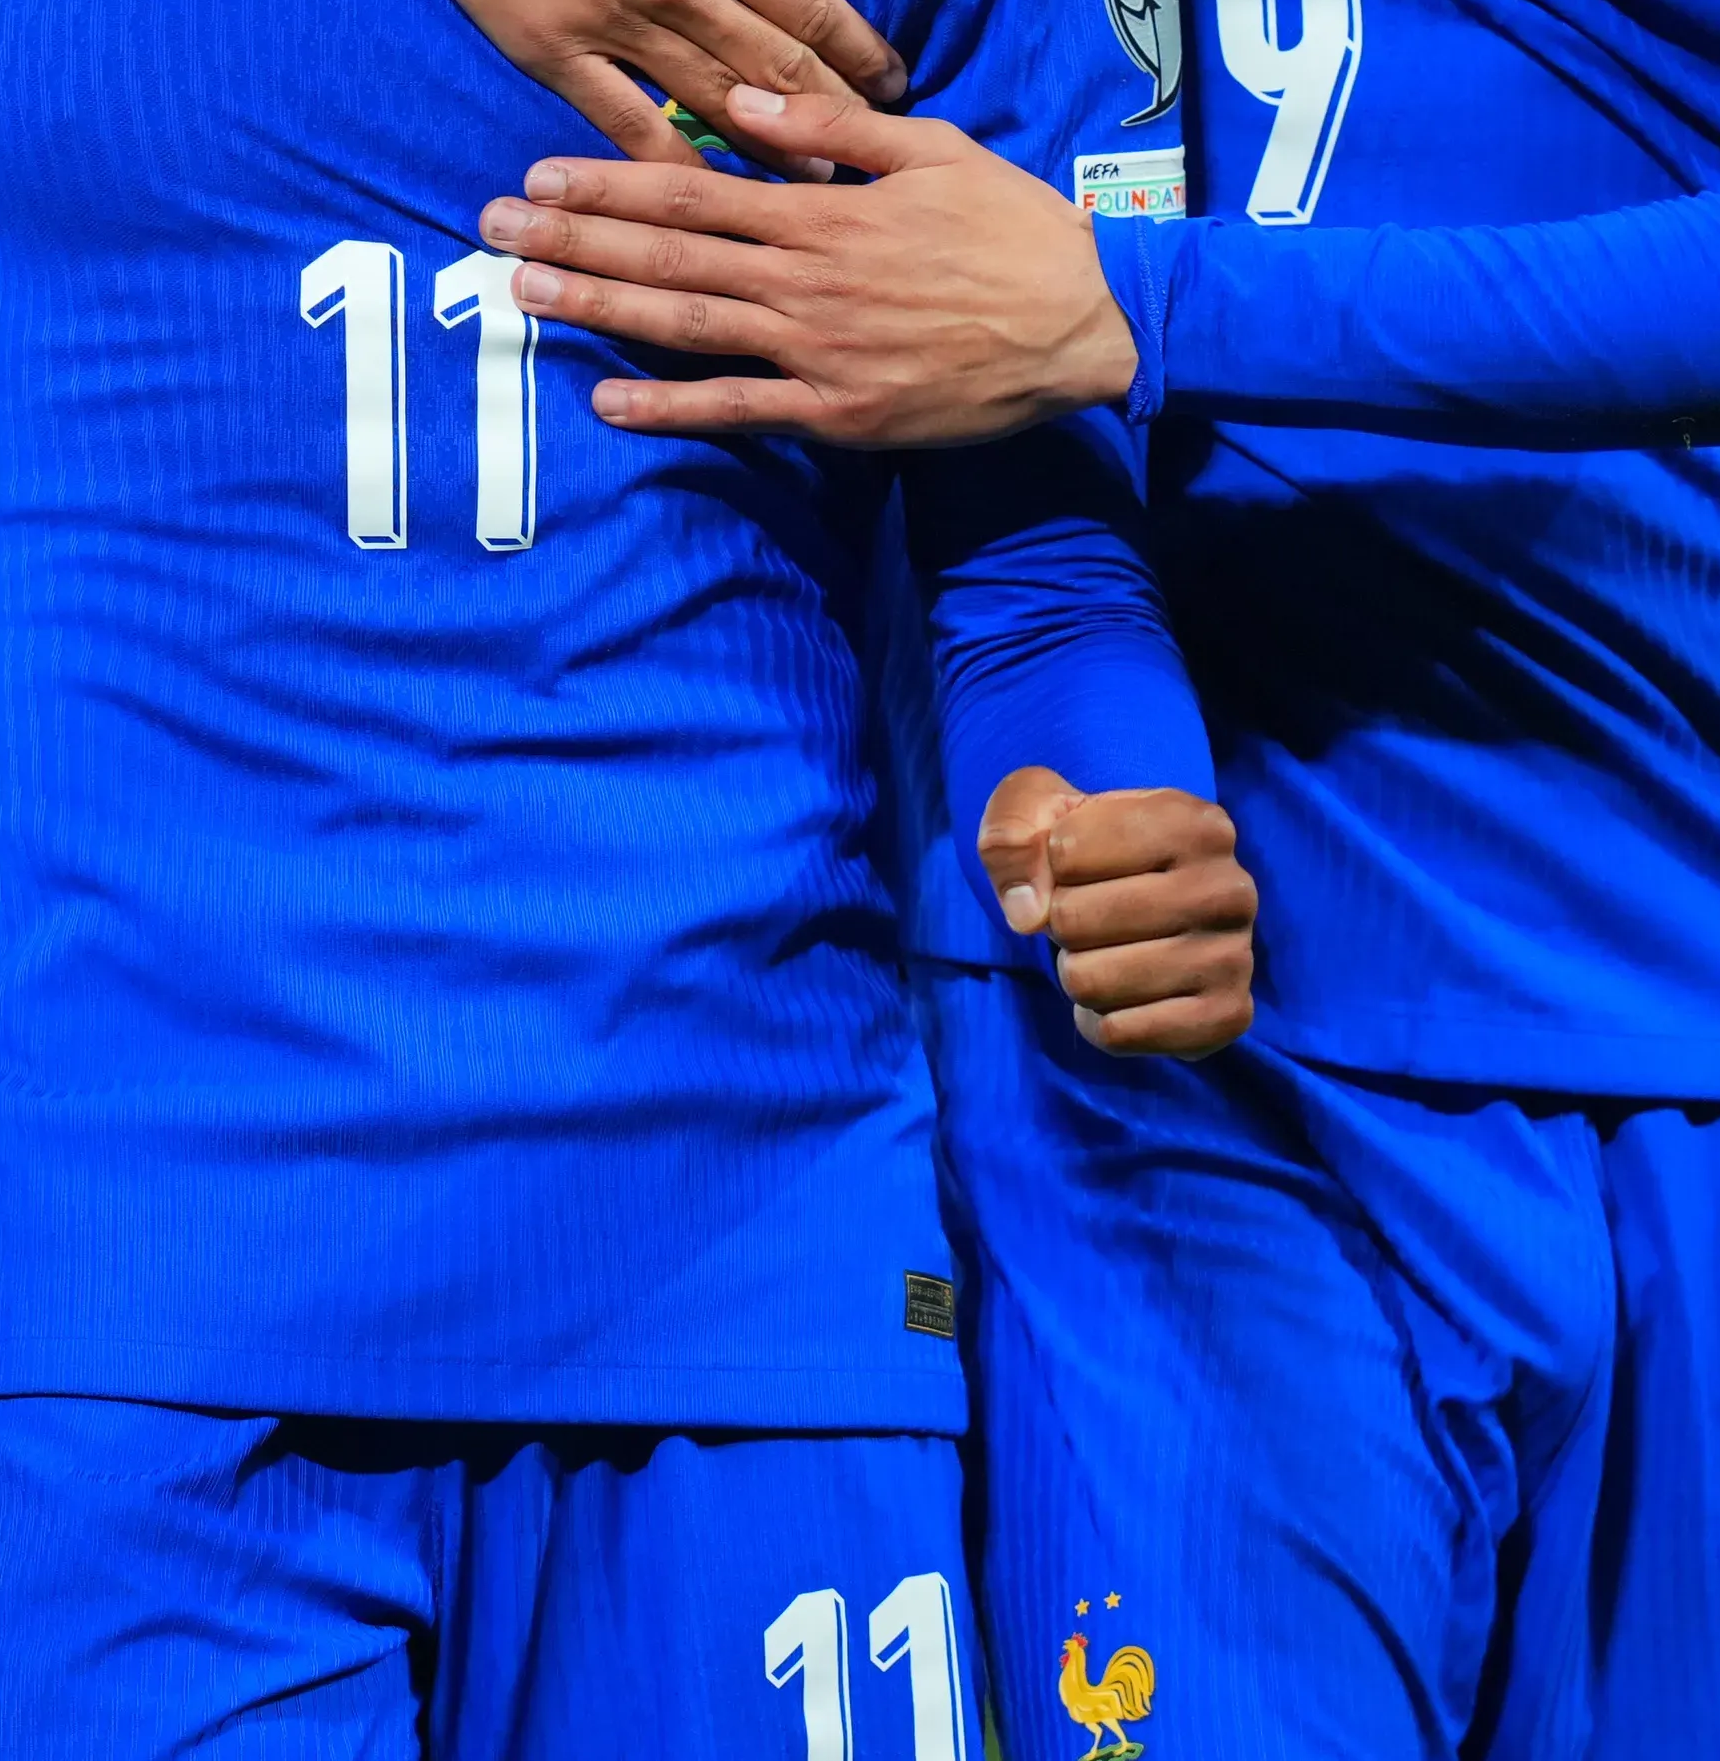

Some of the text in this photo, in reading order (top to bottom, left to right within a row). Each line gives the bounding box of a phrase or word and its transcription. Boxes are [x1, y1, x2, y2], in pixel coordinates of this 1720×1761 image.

[1082, 163, 1120, 180] UEFA
[299, 240, 540, 552] 11
[764, 1571, 967, 1761] 11
